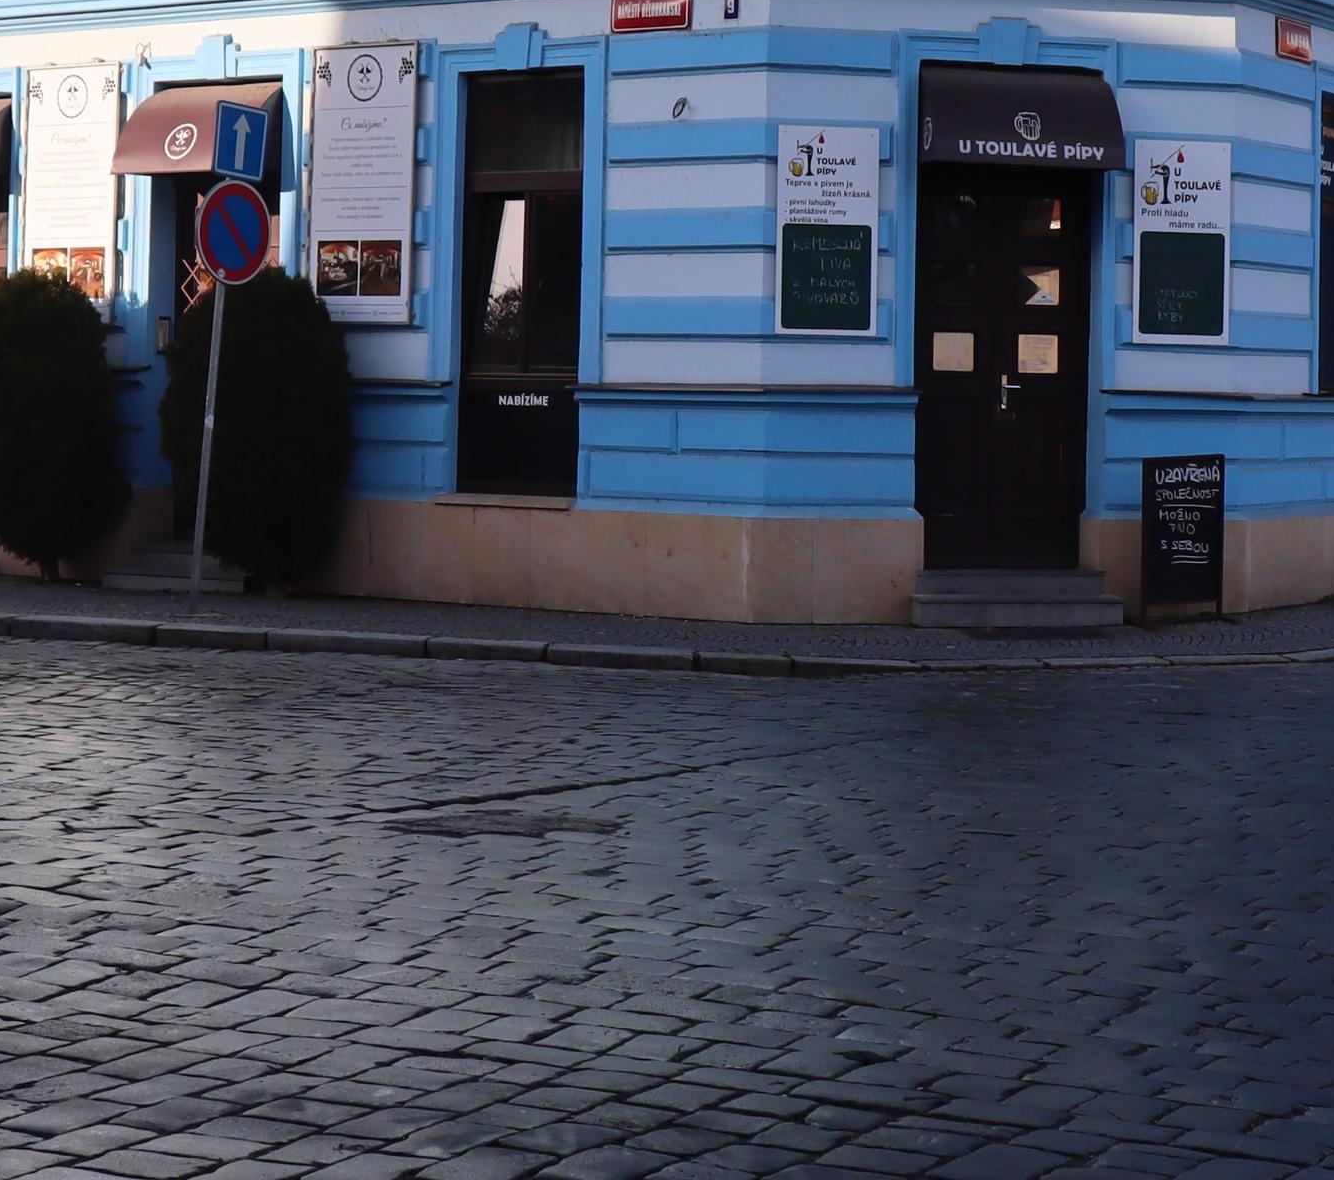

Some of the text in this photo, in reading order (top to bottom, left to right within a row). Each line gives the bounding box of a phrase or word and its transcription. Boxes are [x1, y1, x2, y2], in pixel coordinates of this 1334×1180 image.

[727, 0, 735, 14] 9
[816, 147, 823, 155] U
[959, 139, 1105, 161] U TOULAVÉ PÍPY
[816, 157, 857, 166] TOULAVÉ
[816, 167, 837, 175] PÍPY
[1174, 168, 1182, 176] U
[786, 179, 812, 187] Teprve
[821, 181, 845, 189] pivem
[846, 181, 854, 189] je
[1174, 180, 1222, 191] TOULAVÉ
[1174, 192, 1199, 203] PÍPY
[829, 209, 848, 217] rumy
[1141, 208, 1189, 218] Proti hladu
[1169, 221, 1196, 229] máme
[498, 392, 549, 406] NABÍZÍME
[1155, 460, 1221, 485] UZAVŘENÁ
[1155, 487, 1220, 501] SPOLEČNOST
[1159, 508, 1201, 521] MOŽNO
[1171, 540, 1210, 553] SEBOU
